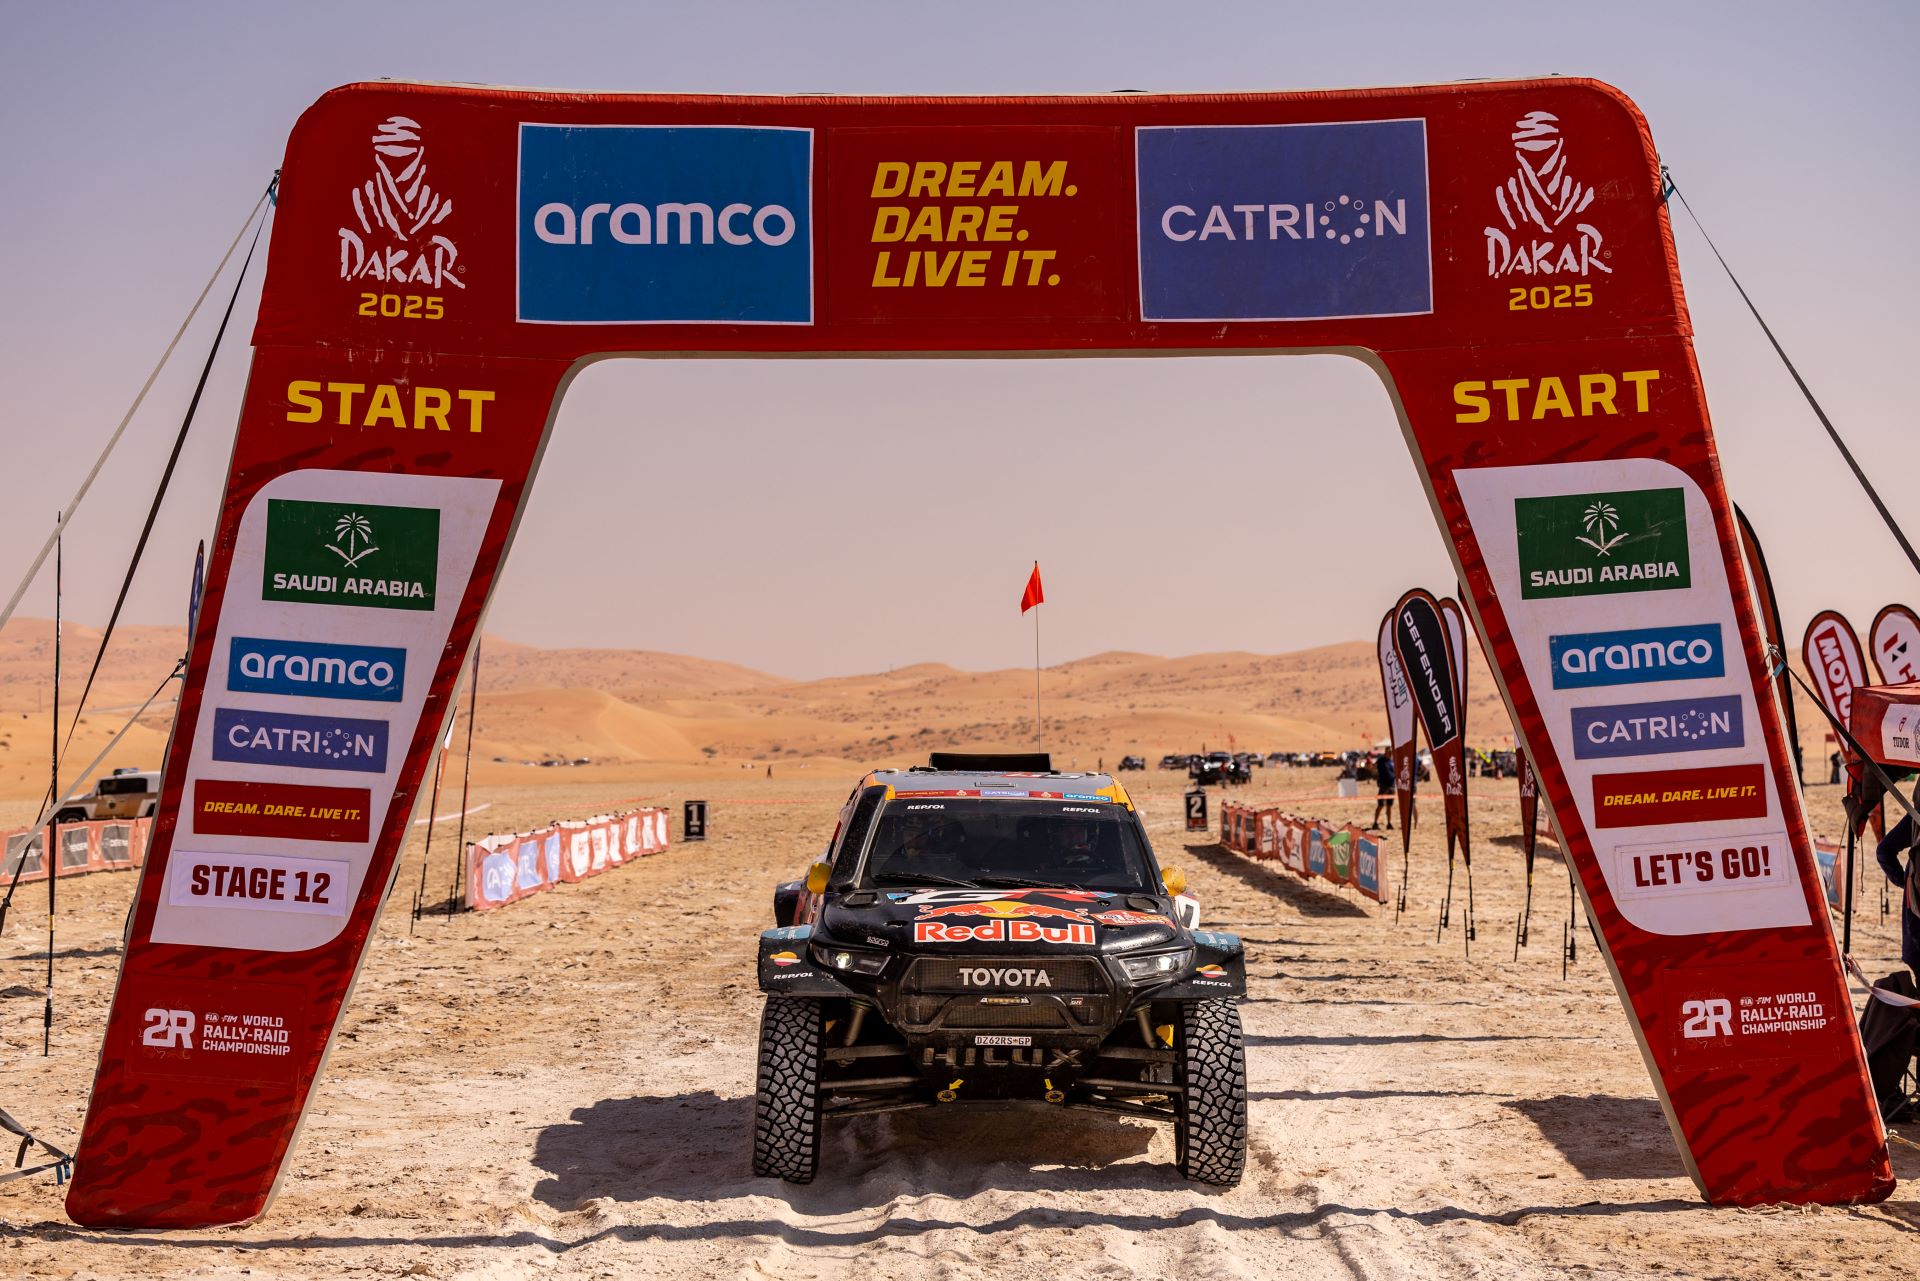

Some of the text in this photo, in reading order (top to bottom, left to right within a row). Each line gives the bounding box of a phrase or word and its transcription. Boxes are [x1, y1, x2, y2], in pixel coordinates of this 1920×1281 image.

[870, 160, 1078, 198] DREAM.
[534, 203, 796, 247] aramco
[870, 206, 1029, 243] DARE.
[1161, 193, 1407, 245] CATRION
[338, 228, 466, 289] DAKAR
[1484, 224, 1613, 278] DAKAR
[871, 250, 1060, 288] LIVE IT.
[358, 293, 444, 320] 2025
[1509, 283, 1594, 311] 2025
[286, 380, 496, 433] START
[1452, 369, 1661, 424] START
[273, 573, 425, 599] SAUDI ARABIA
[1530, 561, 1680, 587] SAUDI ARABIA
[1562, 638, 1712, 674] aramco
[240, 652, 394, 688] aramco
[1403, 610, 1452, 735] DEFENDER
[1818, 636, 1851, 735] MOTU
[1586, 709, 1731, 744] CATRION
[228, 725, 374, 759] CATRION
[1892, 736, 1910, 749] TUDOR
[1190, 796, 1203, 818] 2
[1603, 784, 1758, 806] DREAM. DARE. LIVE IT.
[203, 801, 361, 821] DREAM. DARE. LIVE IT.
[688, 804, 701, 826] 1
[1633, 845, 1771, 888] LET'S GO!
[191, 864, 331, 905] STAGE 12
[915, 920, 1096, 946] Red Bull
[773, 971, 814, 980] REPSOL
[959, 968, 1051, 987] TOYOTA
[1192, 979, 1233, 988] REPSOL
[1776, 992, 1816, 1005] WORLD
[242, 1014, 284, 1028] WORLD
[1740, 1003, 1824, 1023] RALLY-RAID
[1741, 1018, 1827, 1035] CHAMPIONSHIP
[203, 1024, 289, 1043] RALLY-RAID
[202, 1040, 291, 1056] CHAMPIONSHIP
